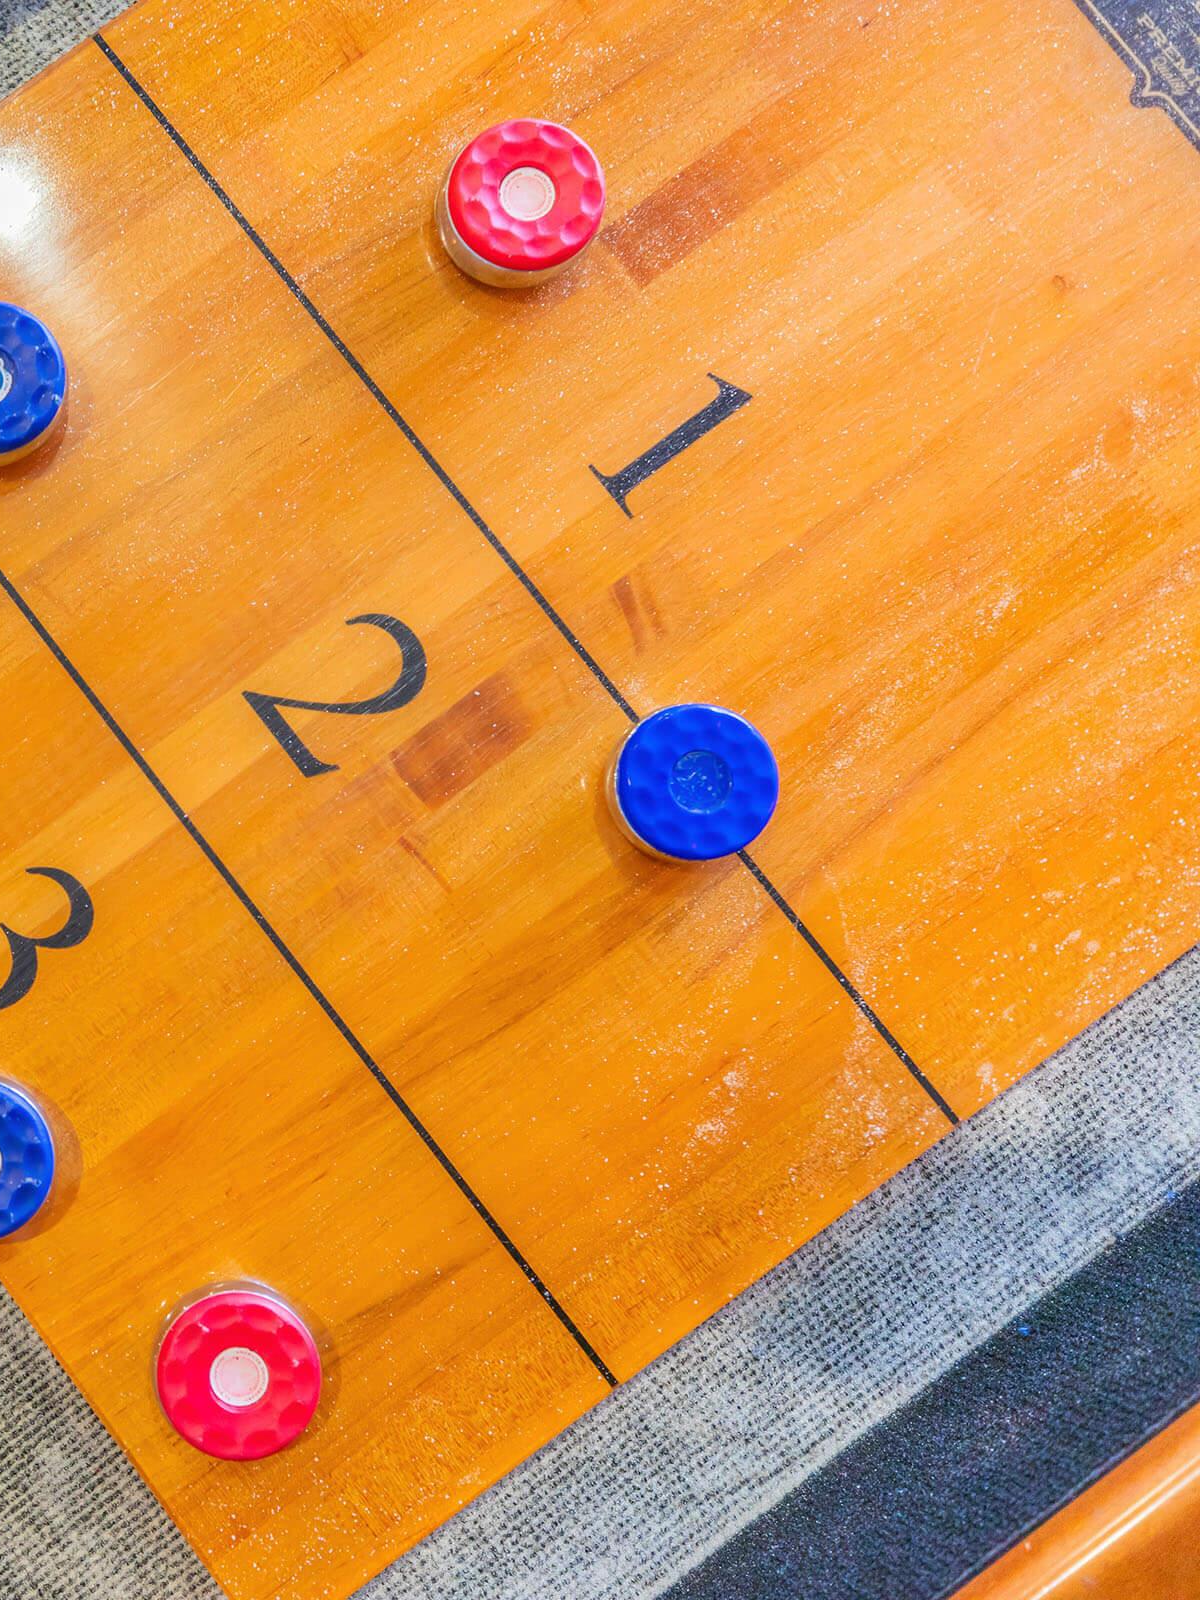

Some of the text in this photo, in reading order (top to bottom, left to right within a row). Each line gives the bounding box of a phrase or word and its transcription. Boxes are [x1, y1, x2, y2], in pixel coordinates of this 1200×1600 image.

[1151, 56, 1190, 96] Quality
[588, 372, 753, 519] 1
[241, 613, 427, 778] 2
